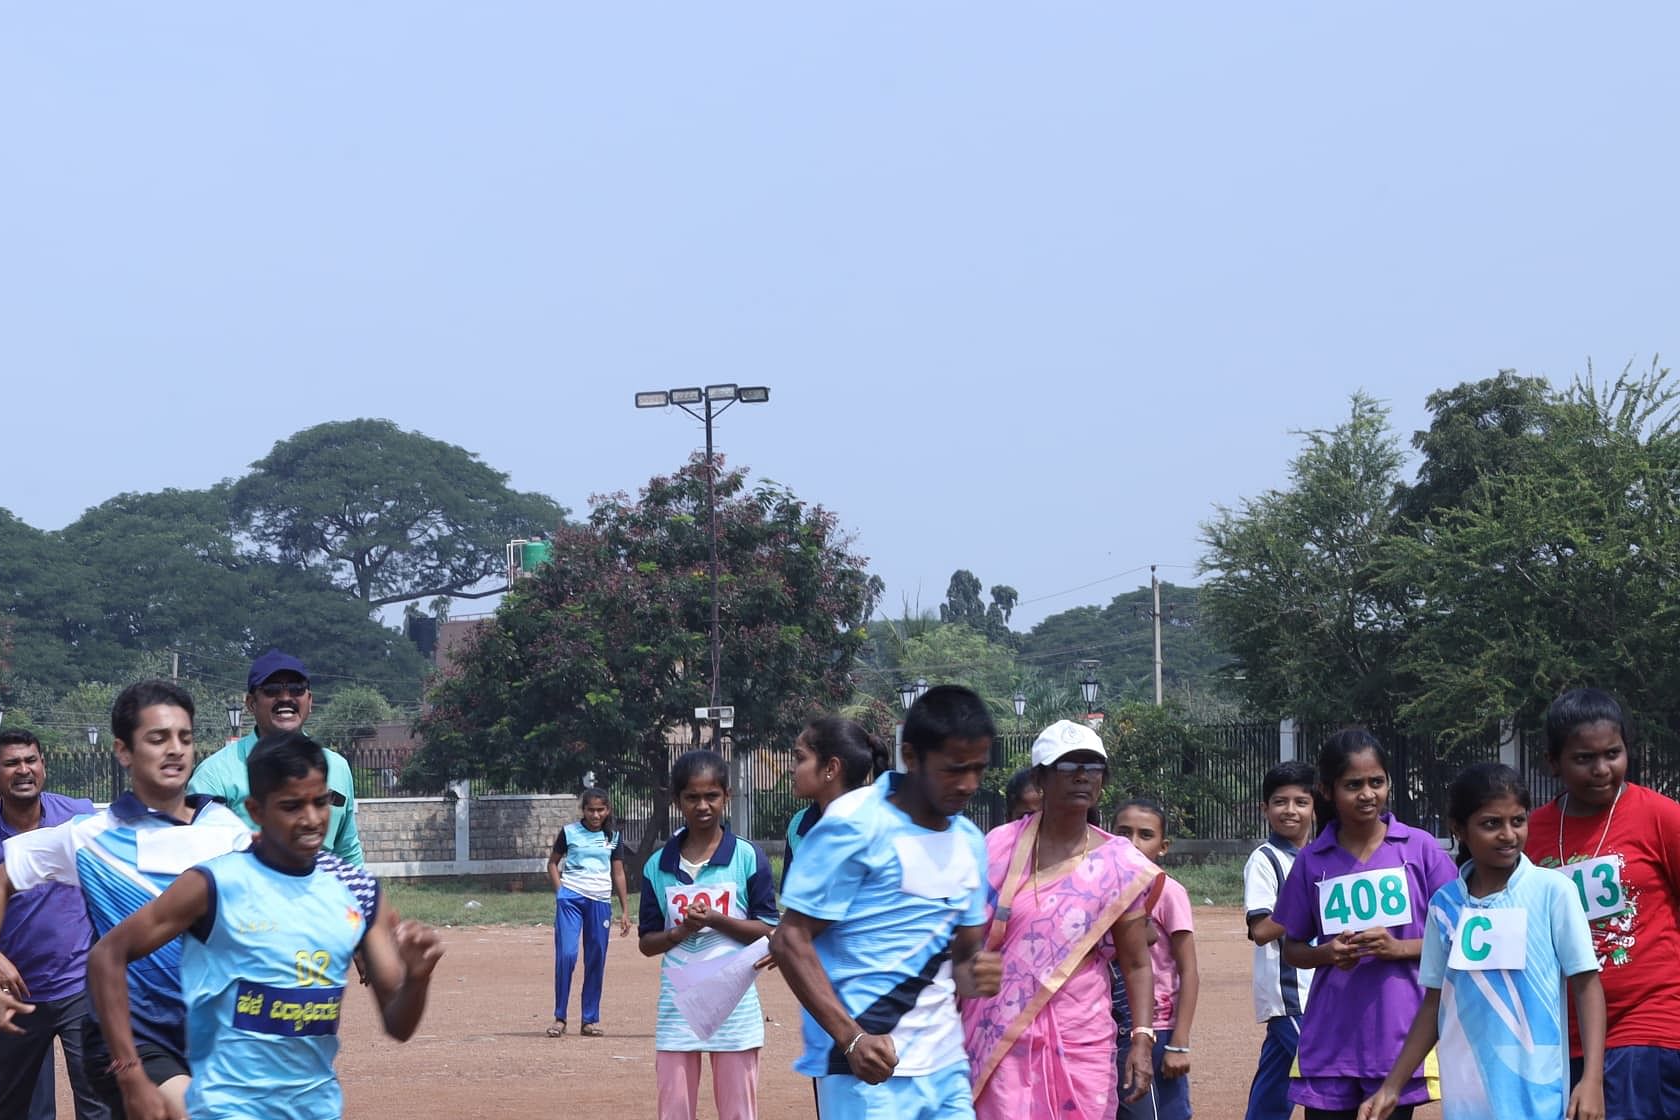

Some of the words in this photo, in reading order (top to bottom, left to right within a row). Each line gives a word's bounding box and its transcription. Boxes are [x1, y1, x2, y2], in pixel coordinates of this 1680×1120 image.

[1324, 874, 1407, 924] 408
[1572, 863, 1620, 913] 13
[1461, 915, 1492, 962] C
